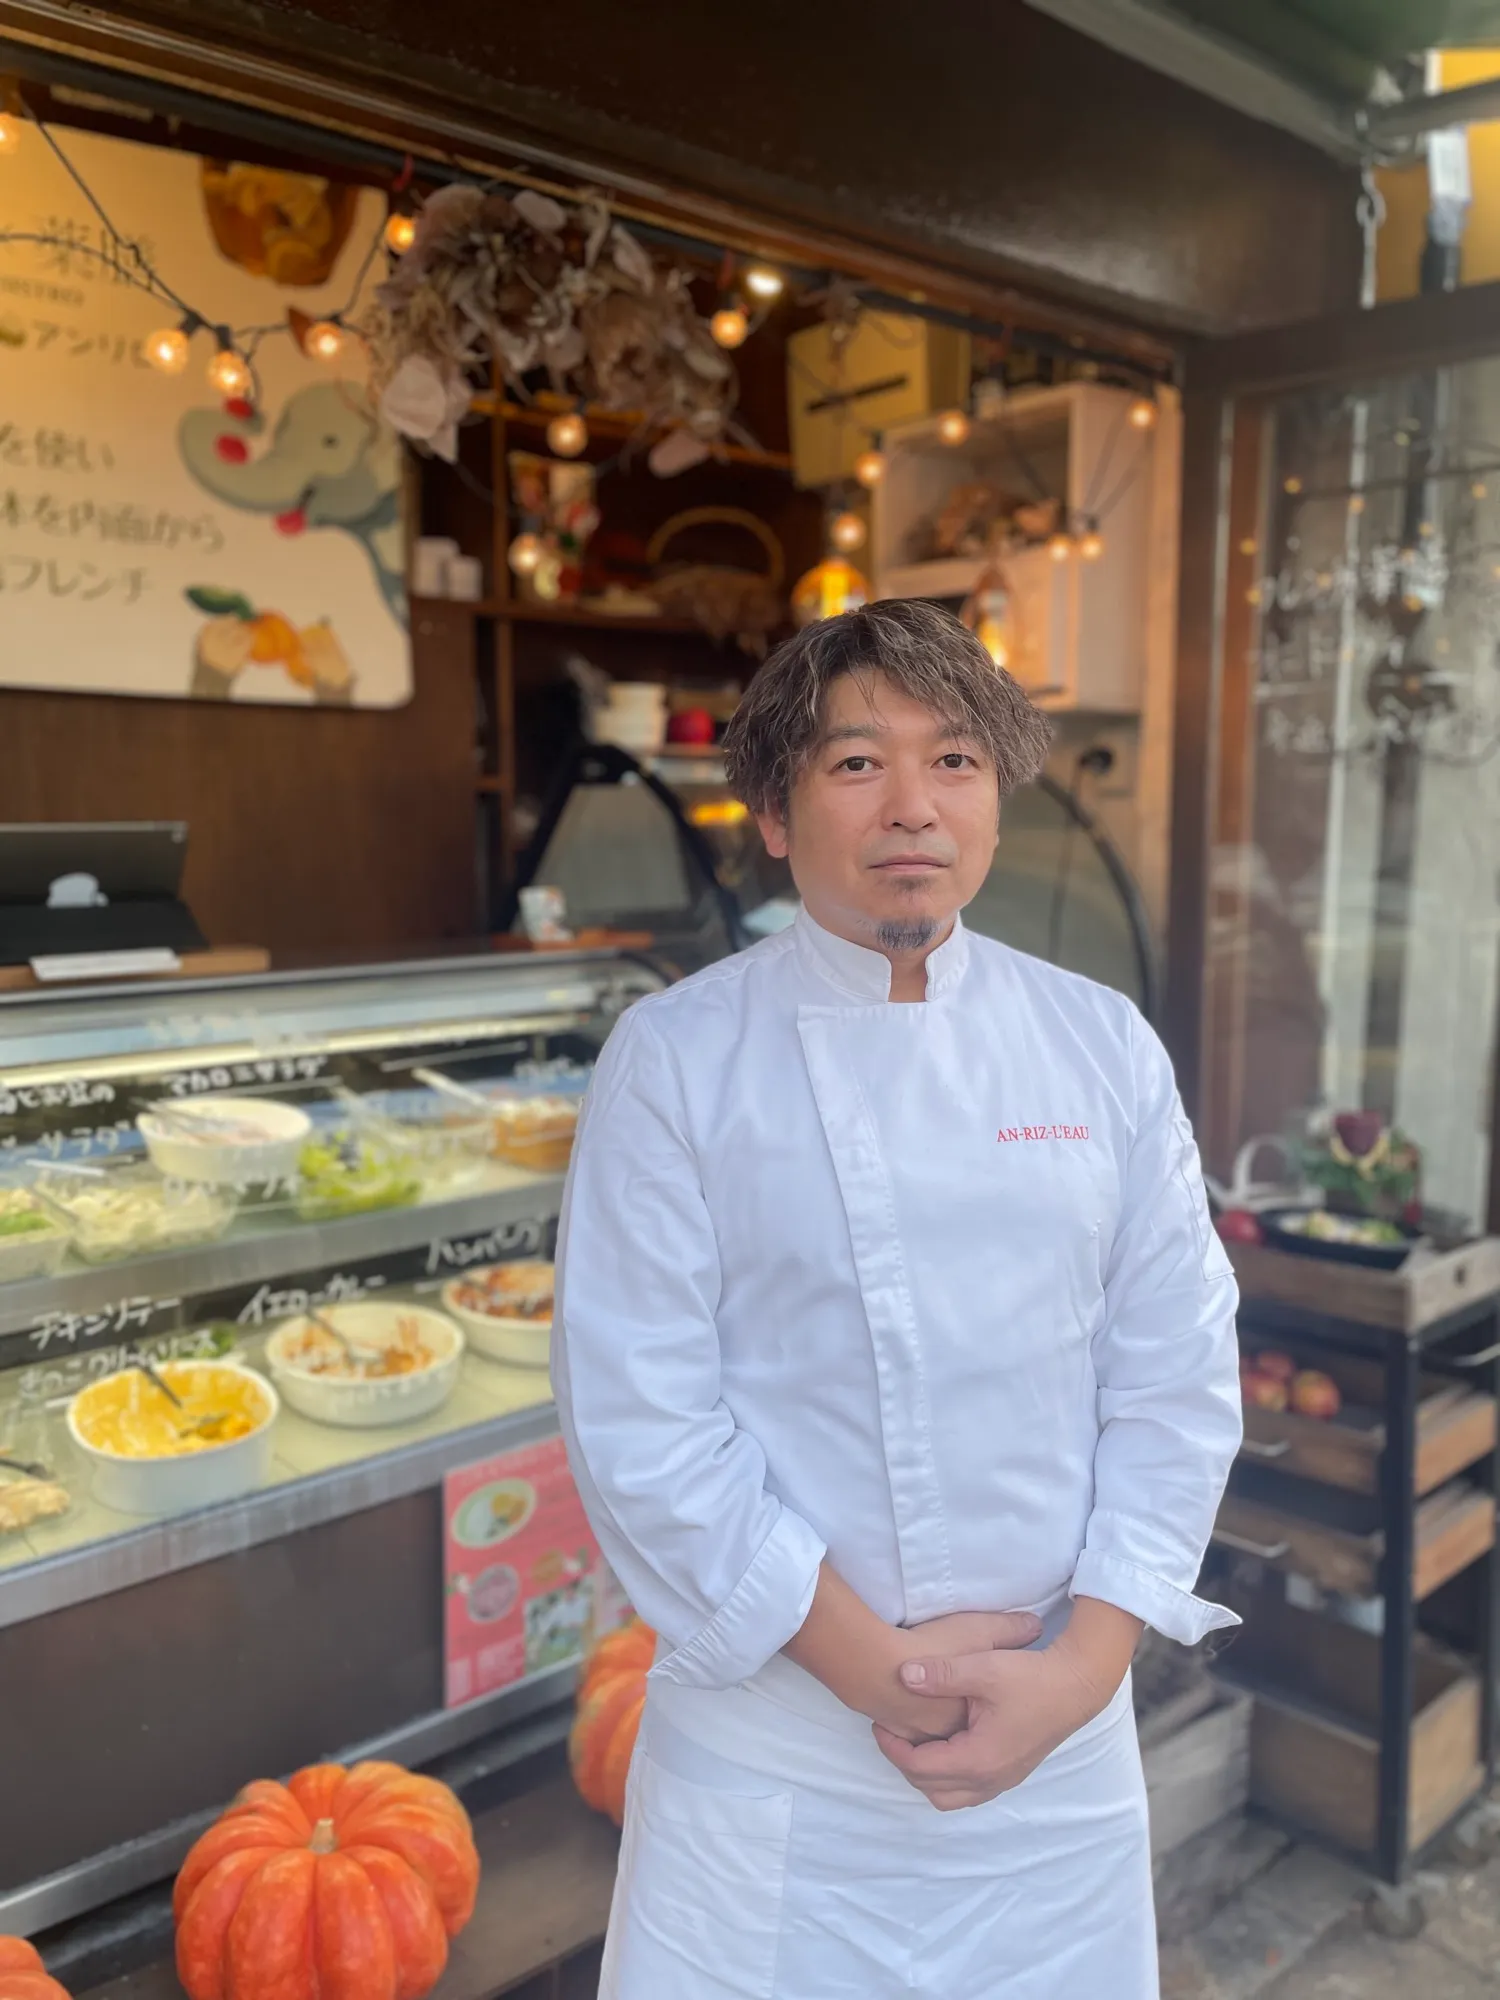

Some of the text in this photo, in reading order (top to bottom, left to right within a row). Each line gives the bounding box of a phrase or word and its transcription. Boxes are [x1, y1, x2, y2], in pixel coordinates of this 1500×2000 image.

[996, 1124, 1090, 1143] AN-RIZ-L'EAU
[236, 1273, 388, 1325] イエローカレー
